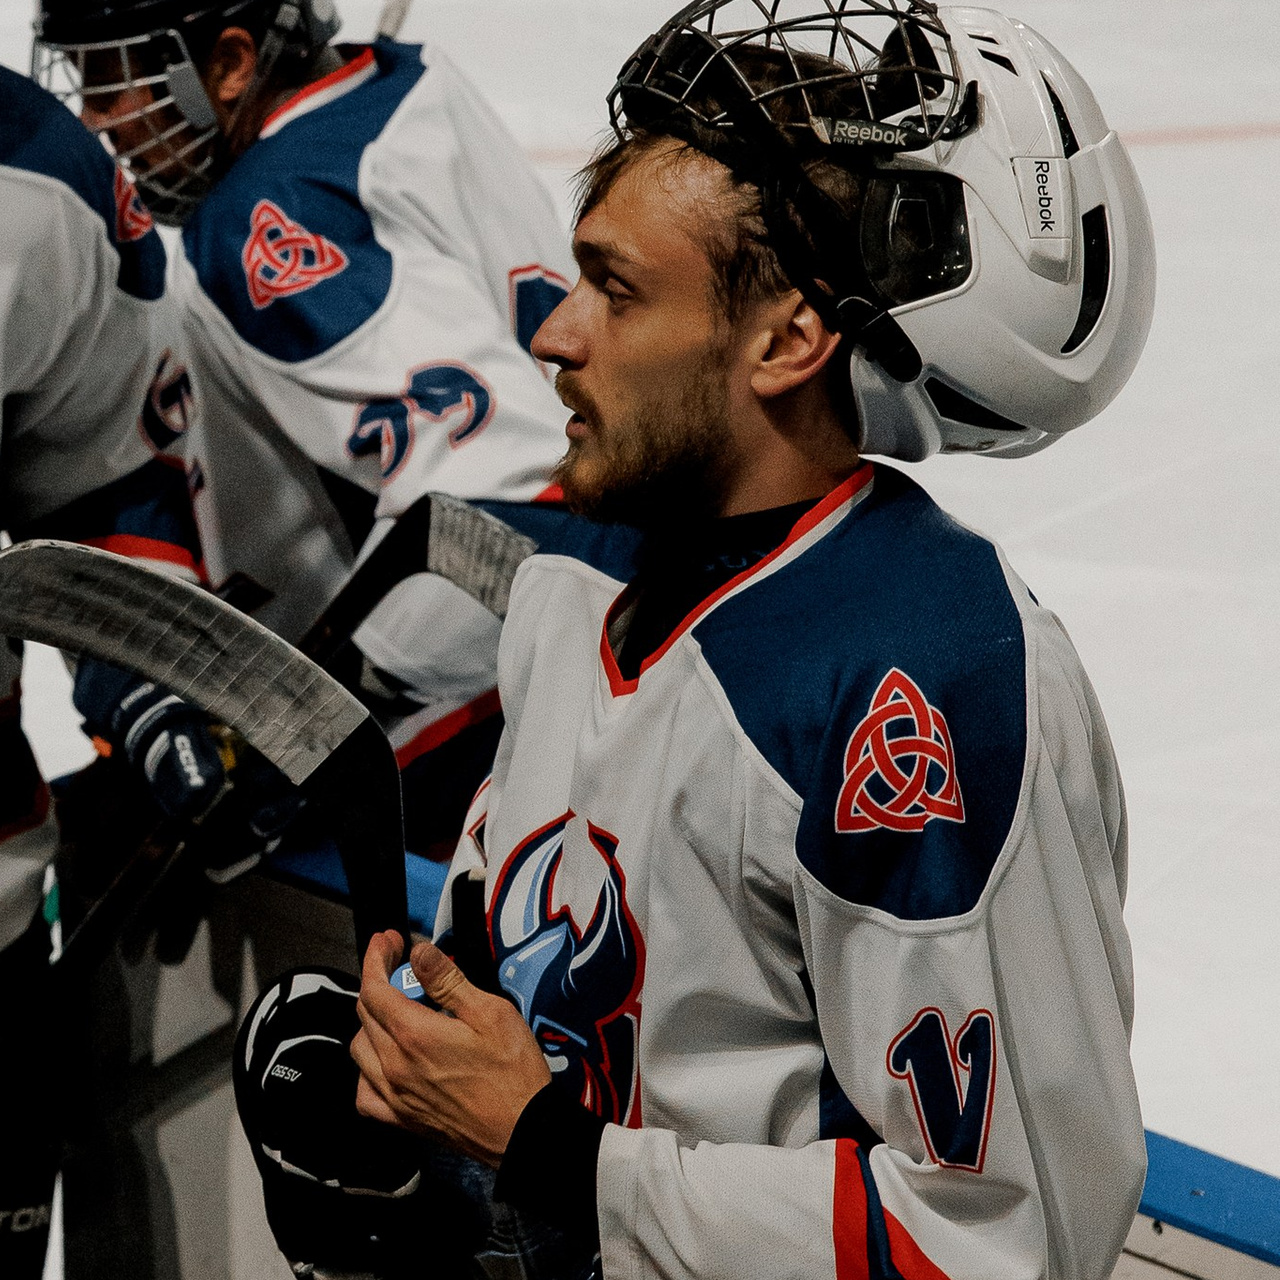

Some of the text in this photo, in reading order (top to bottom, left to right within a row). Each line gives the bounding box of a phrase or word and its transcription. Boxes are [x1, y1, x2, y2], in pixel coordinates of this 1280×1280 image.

[833, 121, 908, 146] Reebok
[1034, 161, 1055, 232] Reebok
[174, 733, 207, 788] CCM
